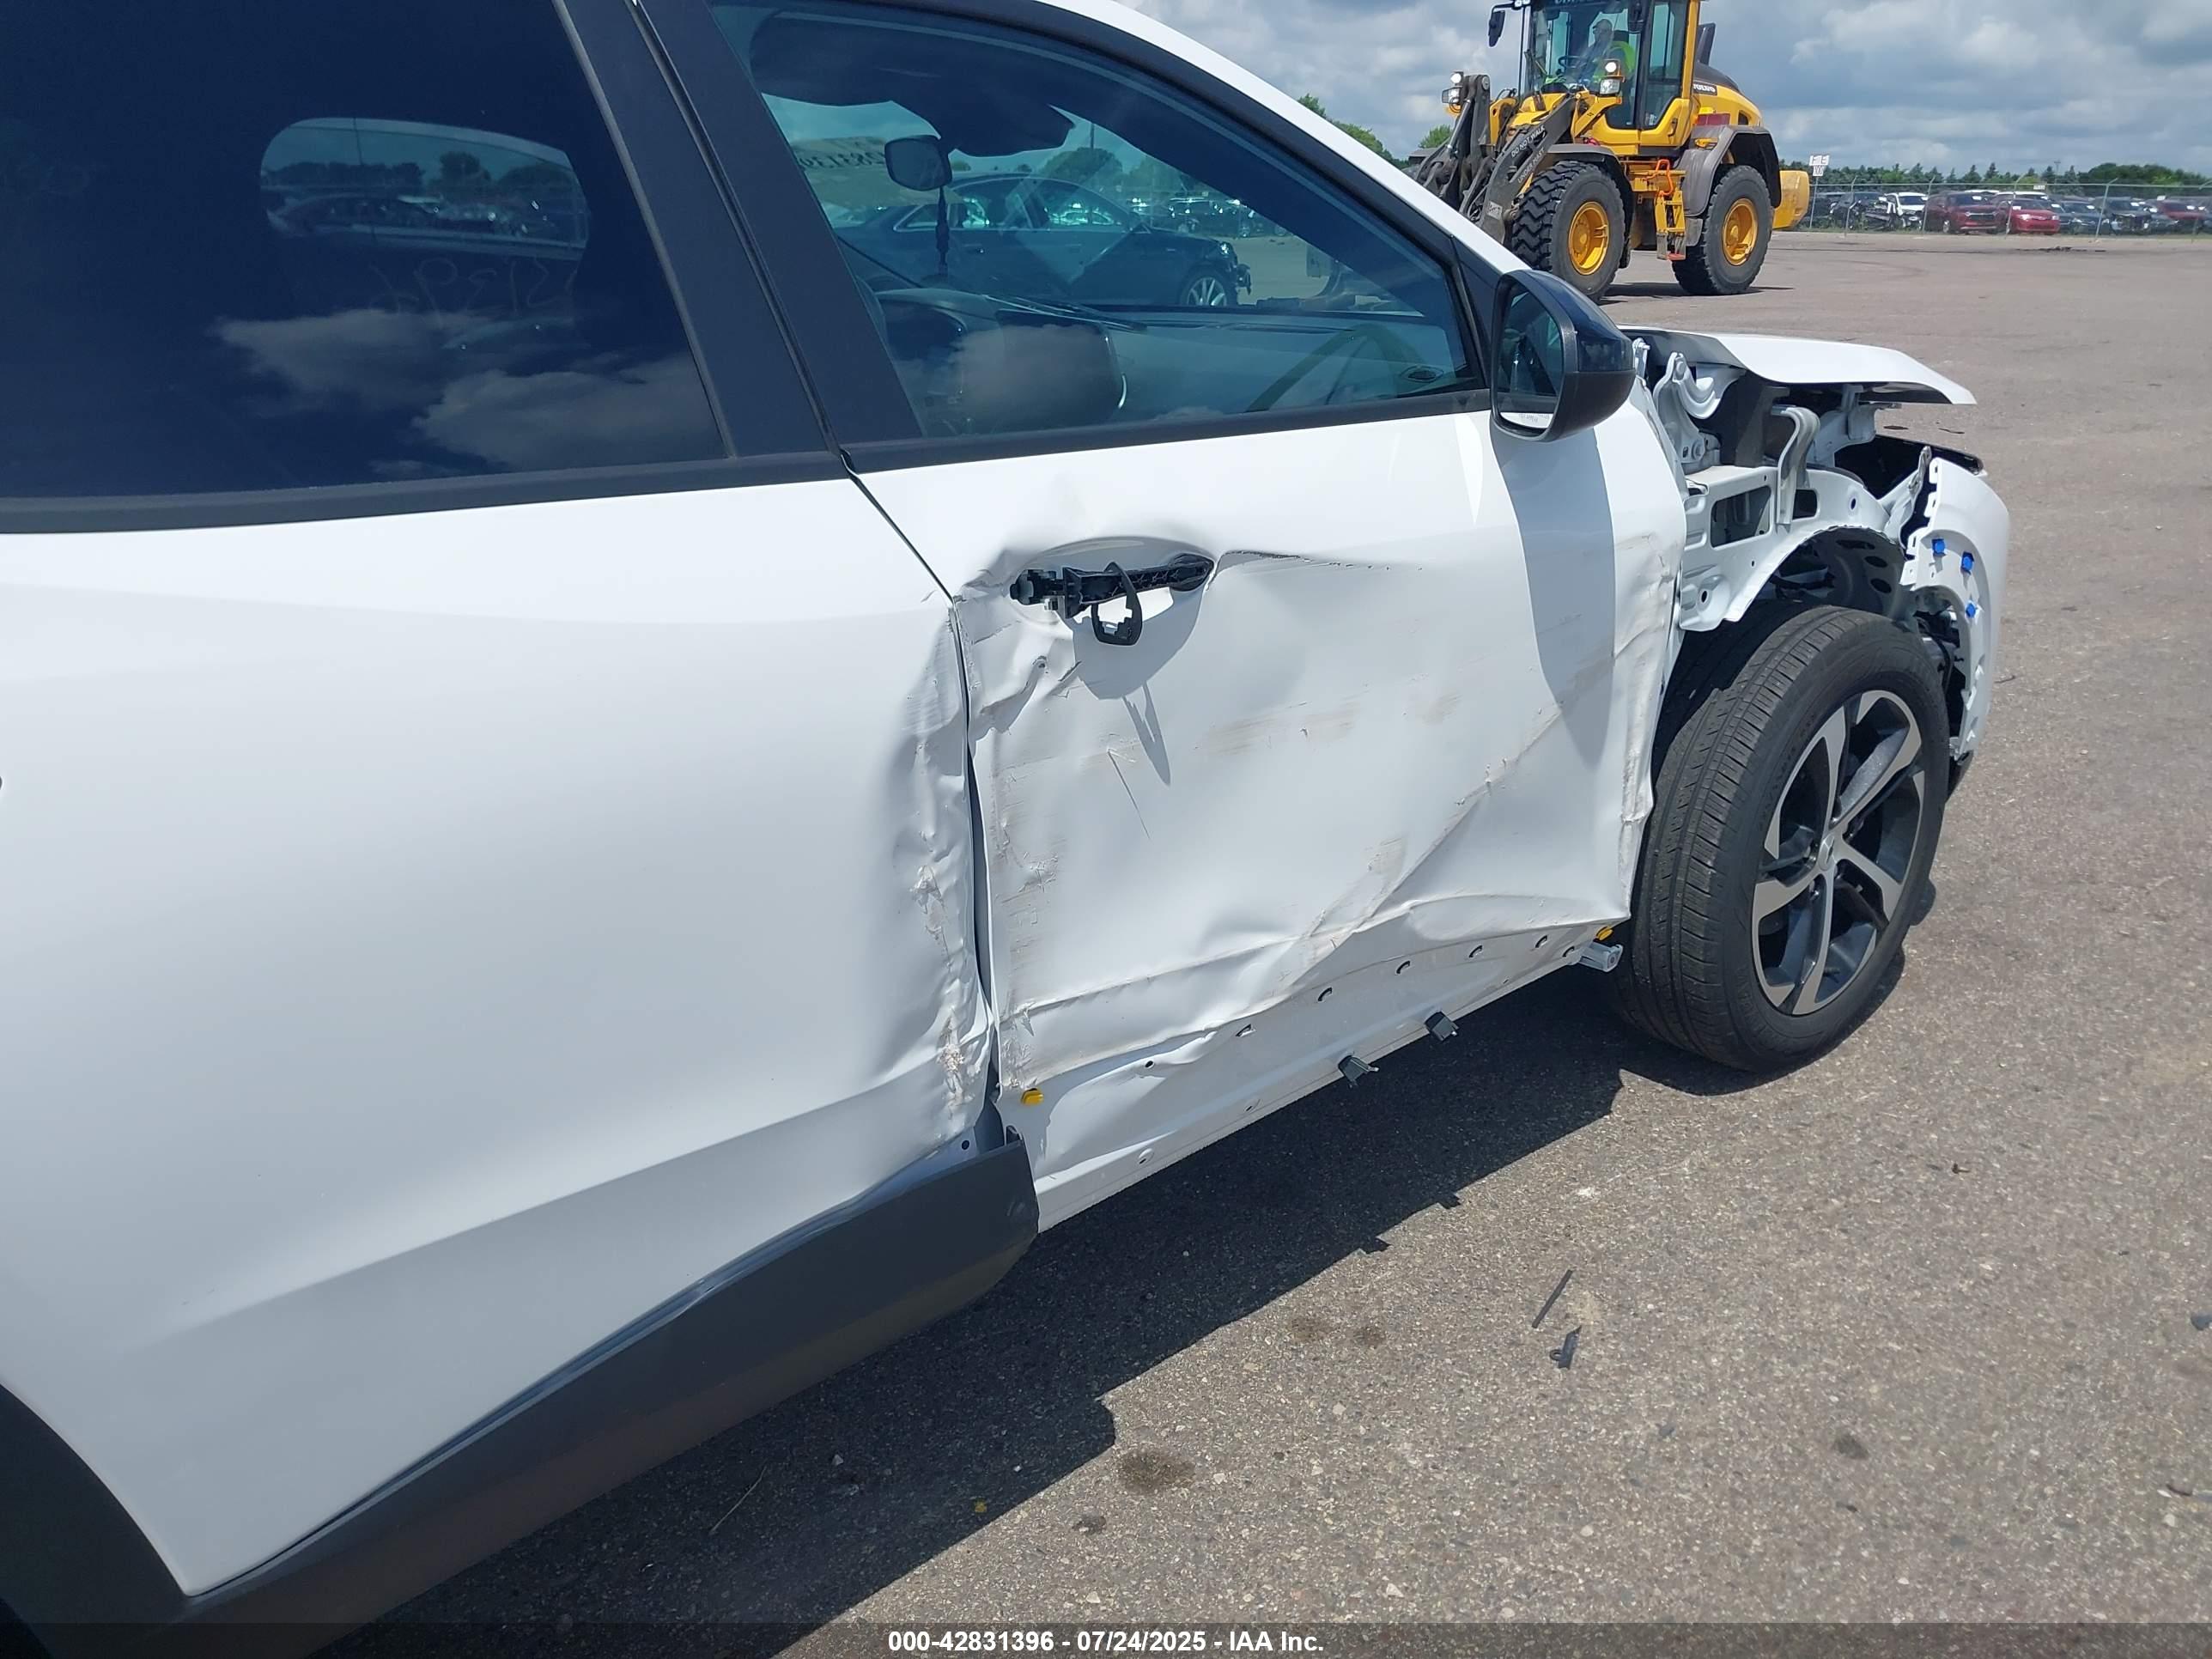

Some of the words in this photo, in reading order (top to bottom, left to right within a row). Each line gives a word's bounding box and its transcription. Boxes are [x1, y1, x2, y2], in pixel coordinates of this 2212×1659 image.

[1692, 83, 1716, 92] VOLVO
[1510, 147, 1520, 158] DO
[1519, 137, 1531, 149] NOT
[1530, 125, 1545, 139] WALK
[1517, 162, 1533, 184] UNDER
[1533, 147, 1545, 165] MAST
